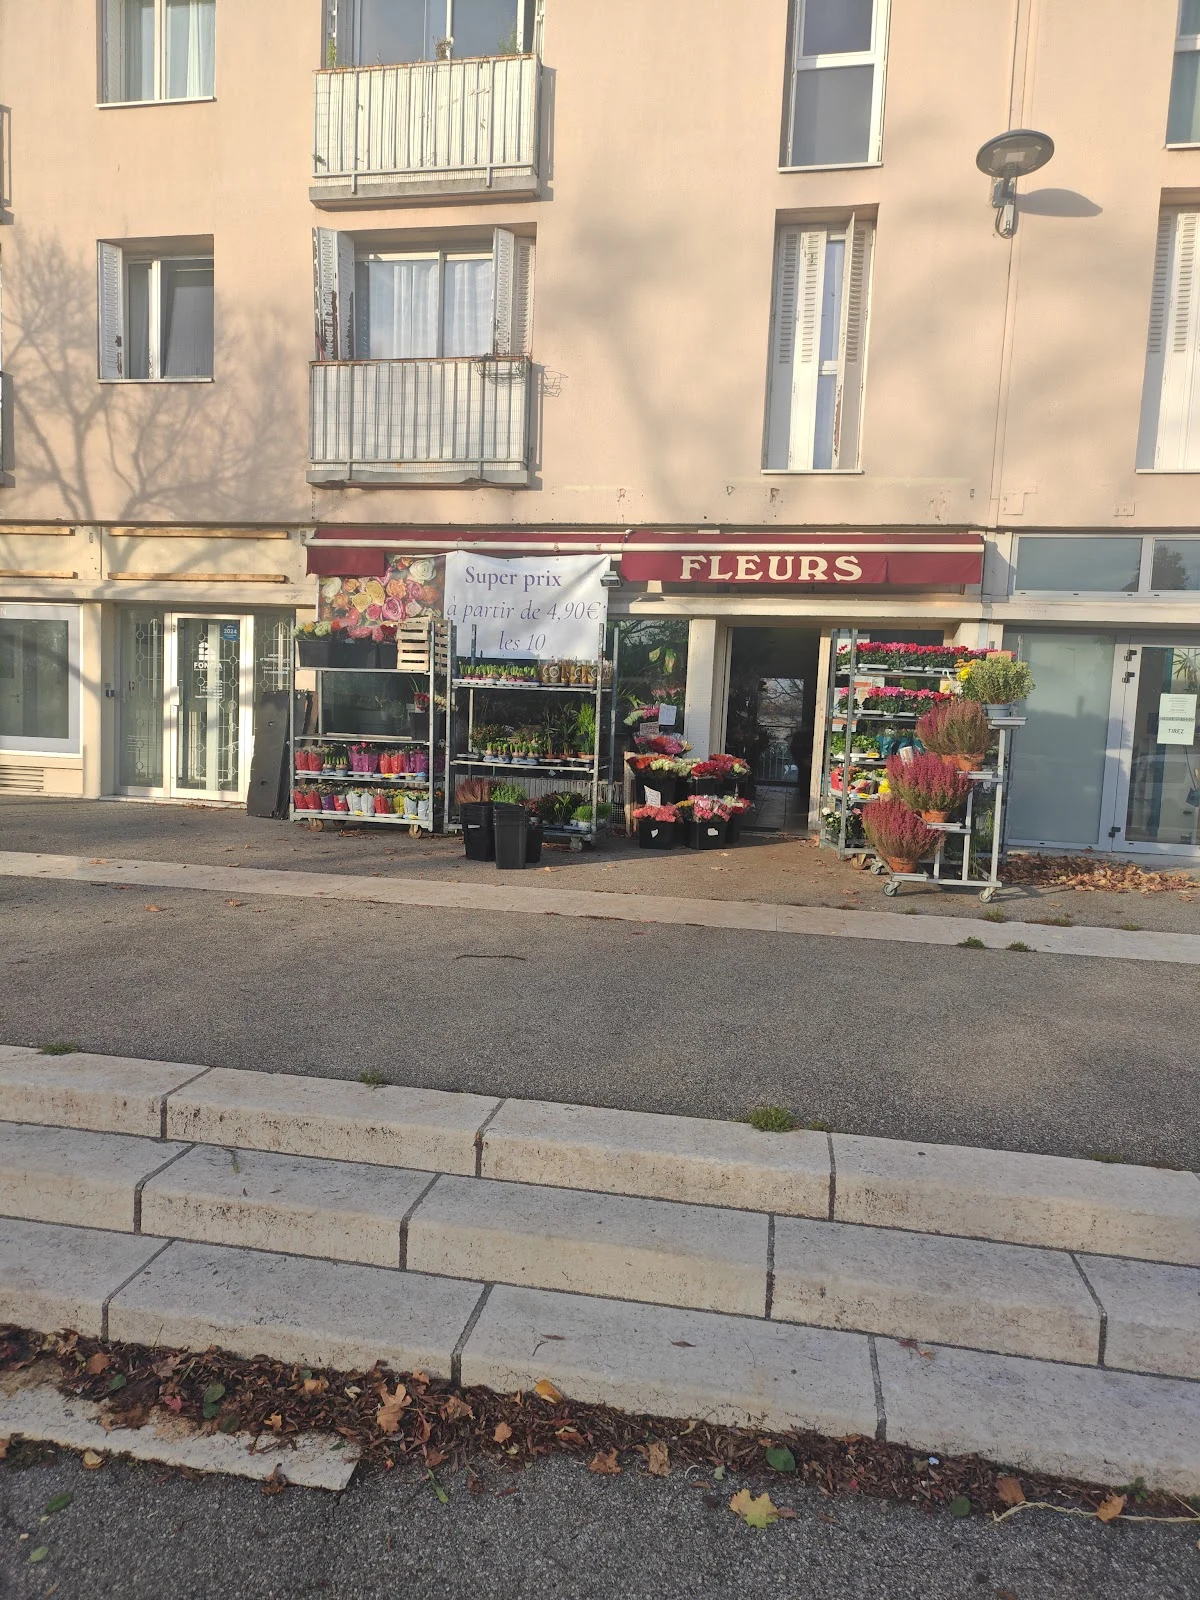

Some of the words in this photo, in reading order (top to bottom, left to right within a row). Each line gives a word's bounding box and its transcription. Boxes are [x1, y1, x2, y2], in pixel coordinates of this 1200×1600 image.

[465, 566, 518, 591] Super
[523, 570, 562, 593] prix
[680, 555, 862, 581] FLEURS
[447, 595, 457, 616] à
[461, 601, 515, 623] partir
[520, 600, 541, 620] de
[546, 602, 602, 623] 4,90€
[498, 631, 521, 651] les
[525, 633, 546, 651] 10
[193, 661, 223, 669] FONCA
